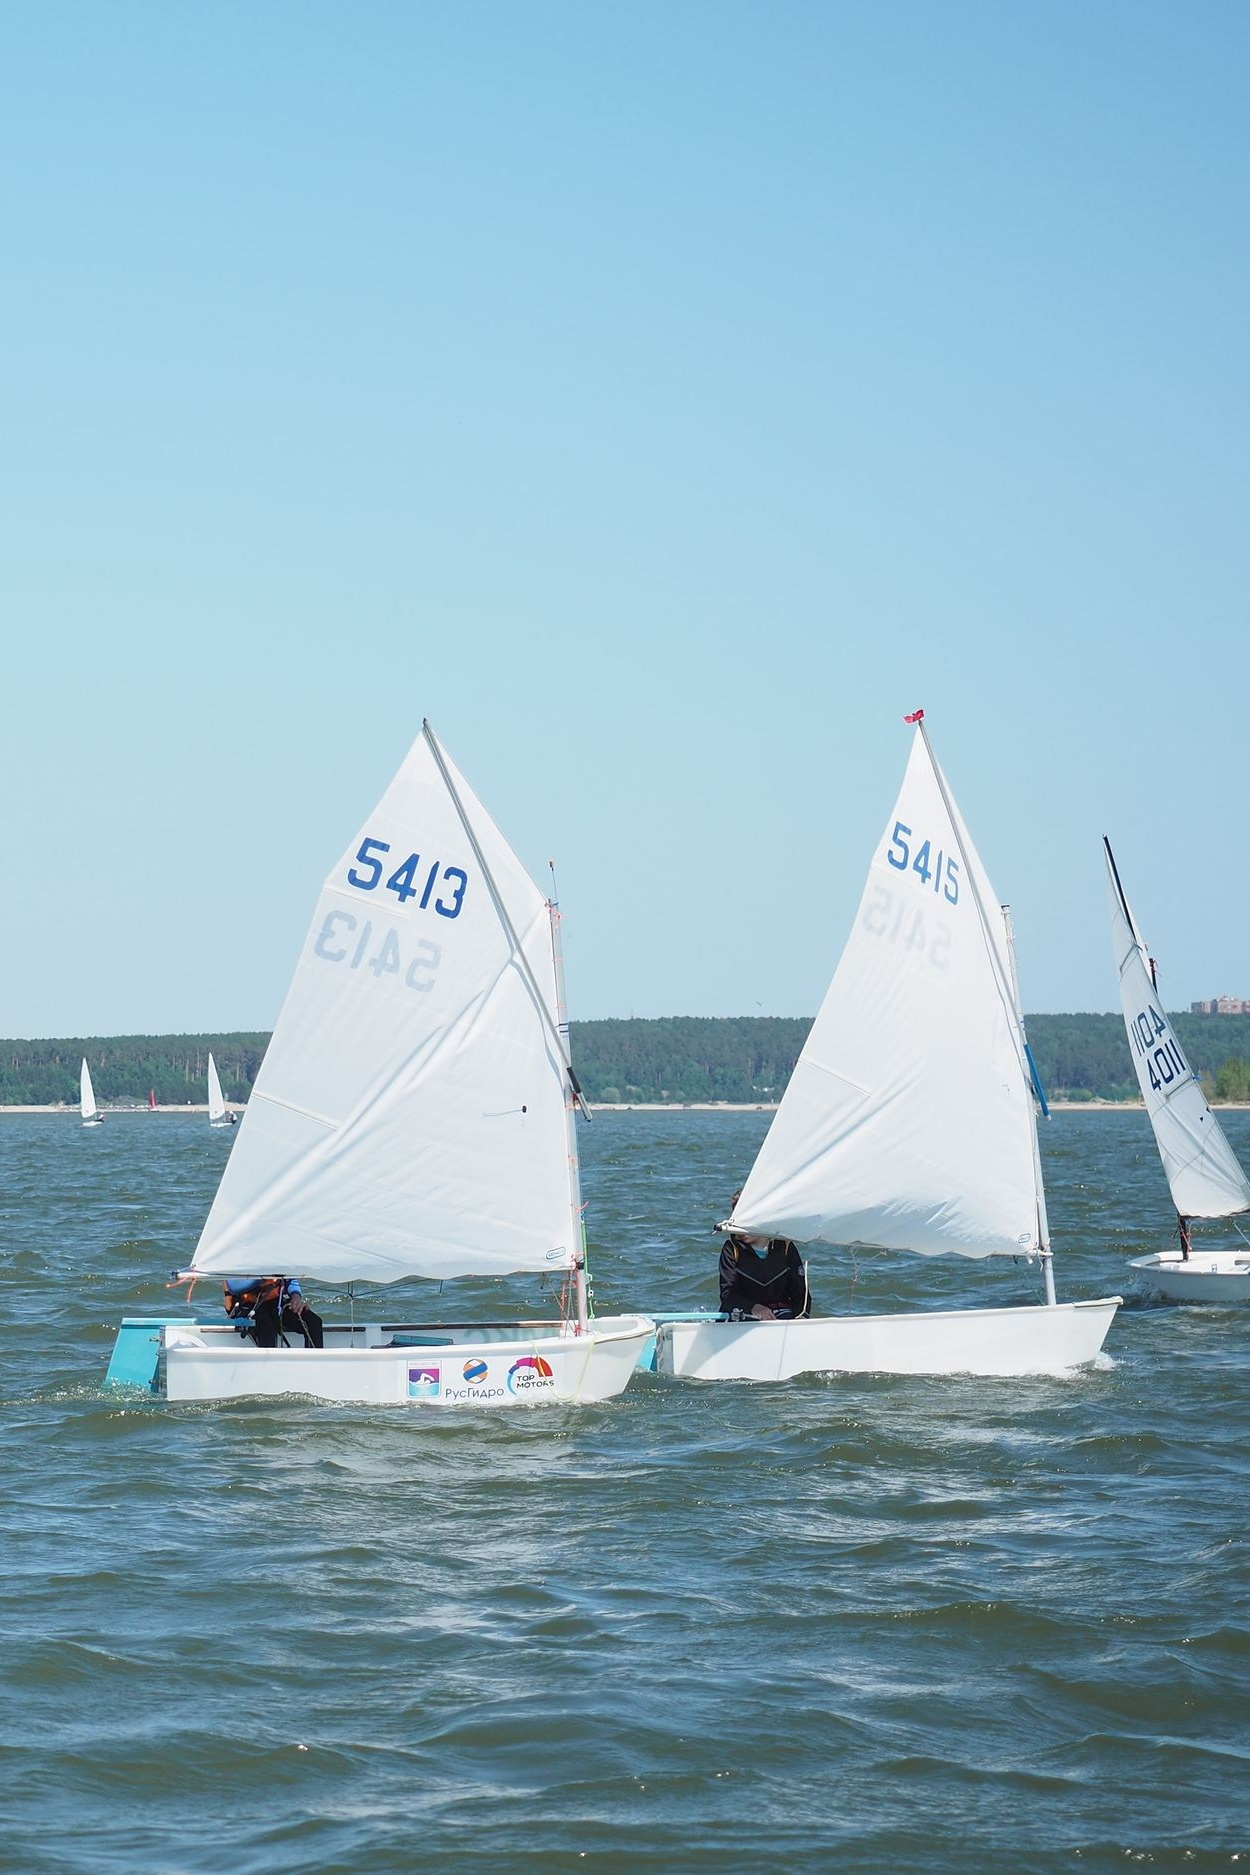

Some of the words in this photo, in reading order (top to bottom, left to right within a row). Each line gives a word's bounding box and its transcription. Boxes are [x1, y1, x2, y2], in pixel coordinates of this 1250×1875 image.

[347, 837, 468, 920] 5413
[887, 821, 959, 906] 5415
[1147, 1038, 1186, 1091] 4011
[445, 1387, 505, 1400] РусГидро
[516, 1374, 535, 1382] TOP
